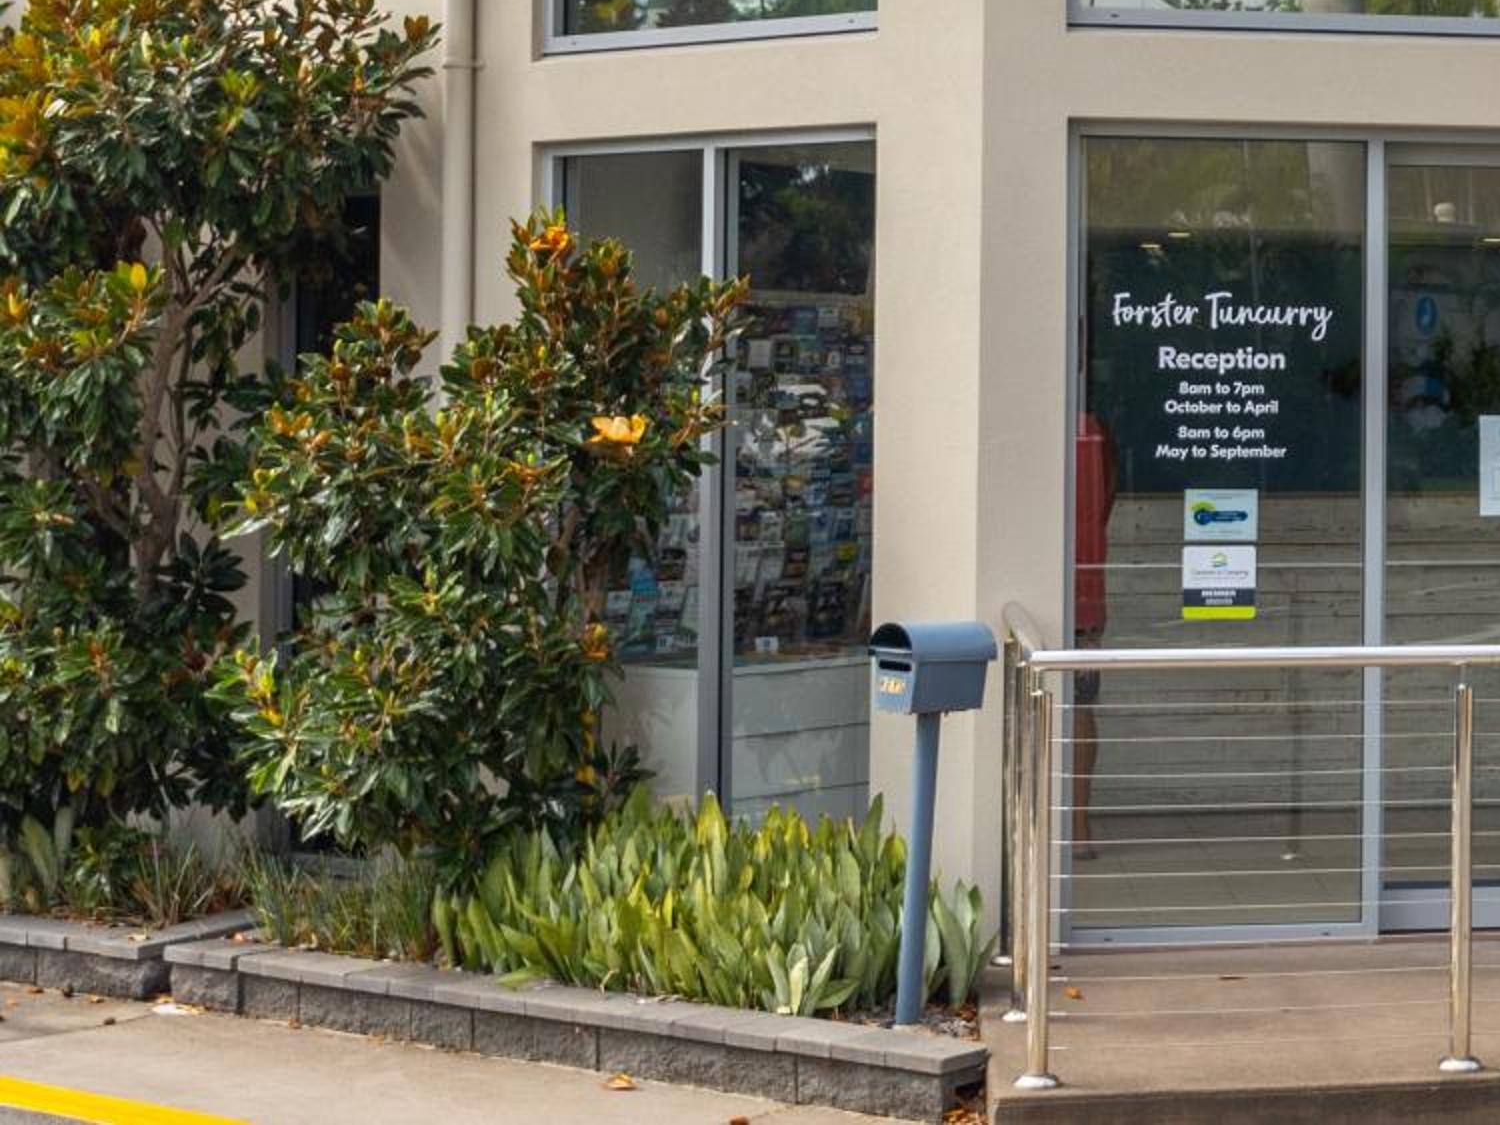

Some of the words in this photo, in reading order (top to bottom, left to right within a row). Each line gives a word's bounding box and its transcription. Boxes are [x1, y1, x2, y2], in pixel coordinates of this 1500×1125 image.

[1112, 291, 1199, 328] Forster
[1204, 291, 1333, 342] Tuncurry
[1158, 346, 1286, 375] Reception
[1179, 381, 1212, 395] 8am
[1215, 382, 1231, 395] to
[1233, 381, 1265, 398] 7pm
[1164, 400, 1223, 414] October
[1226, 401, 1241, 414] to
[1244, 400, 1279, 417] April
[1178, 425, 1211, 439] 8am
[1214, 426, 1229, 439] to
[1232, 425, 1265, 442] 6pm
[1155, 444, 1189, 461] May
[1191, 445, 1207, 458] to
[1210, 444, 1287, 460] September
